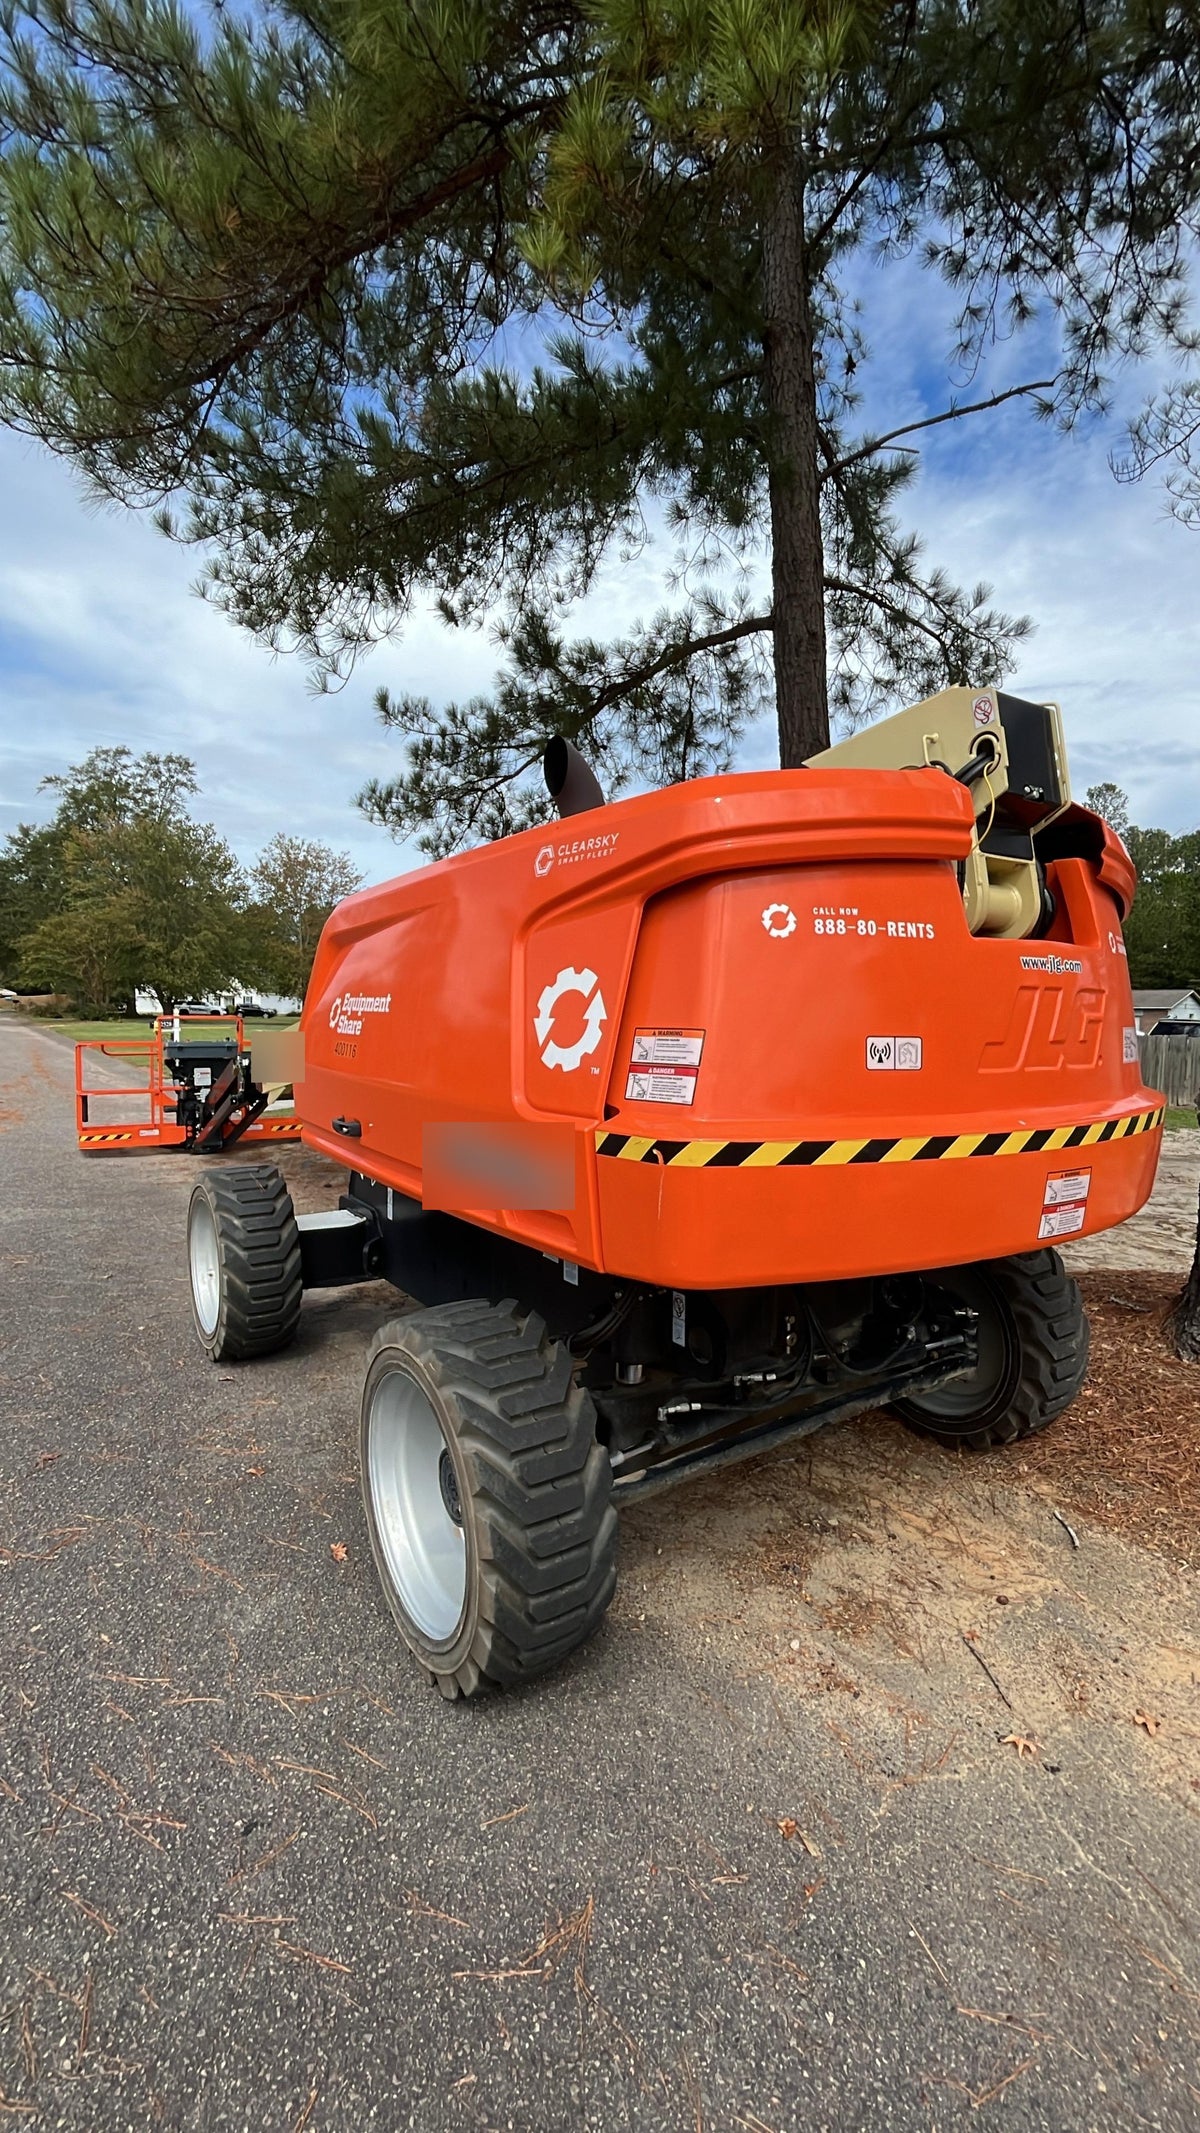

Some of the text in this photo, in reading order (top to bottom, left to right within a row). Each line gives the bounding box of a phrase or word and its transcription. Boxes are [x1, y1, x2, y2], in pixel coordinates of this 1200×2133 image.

[558, 833, 619, 856] CLEARSKY
[587, 848, 613, 860] FLEET
[813, 907, 858, 916] CALL NOW
[814, 918, 935, 939] 888-80-RENTS
[1020, 956, 1082, 973] www.jlg.com
[342, 993, 391, 1016] Equipment
[337, 1015, 362, 1035] Share
[978, 986, 1107, 1073] JLG
[334, 1042, 357, 1058] 400116
